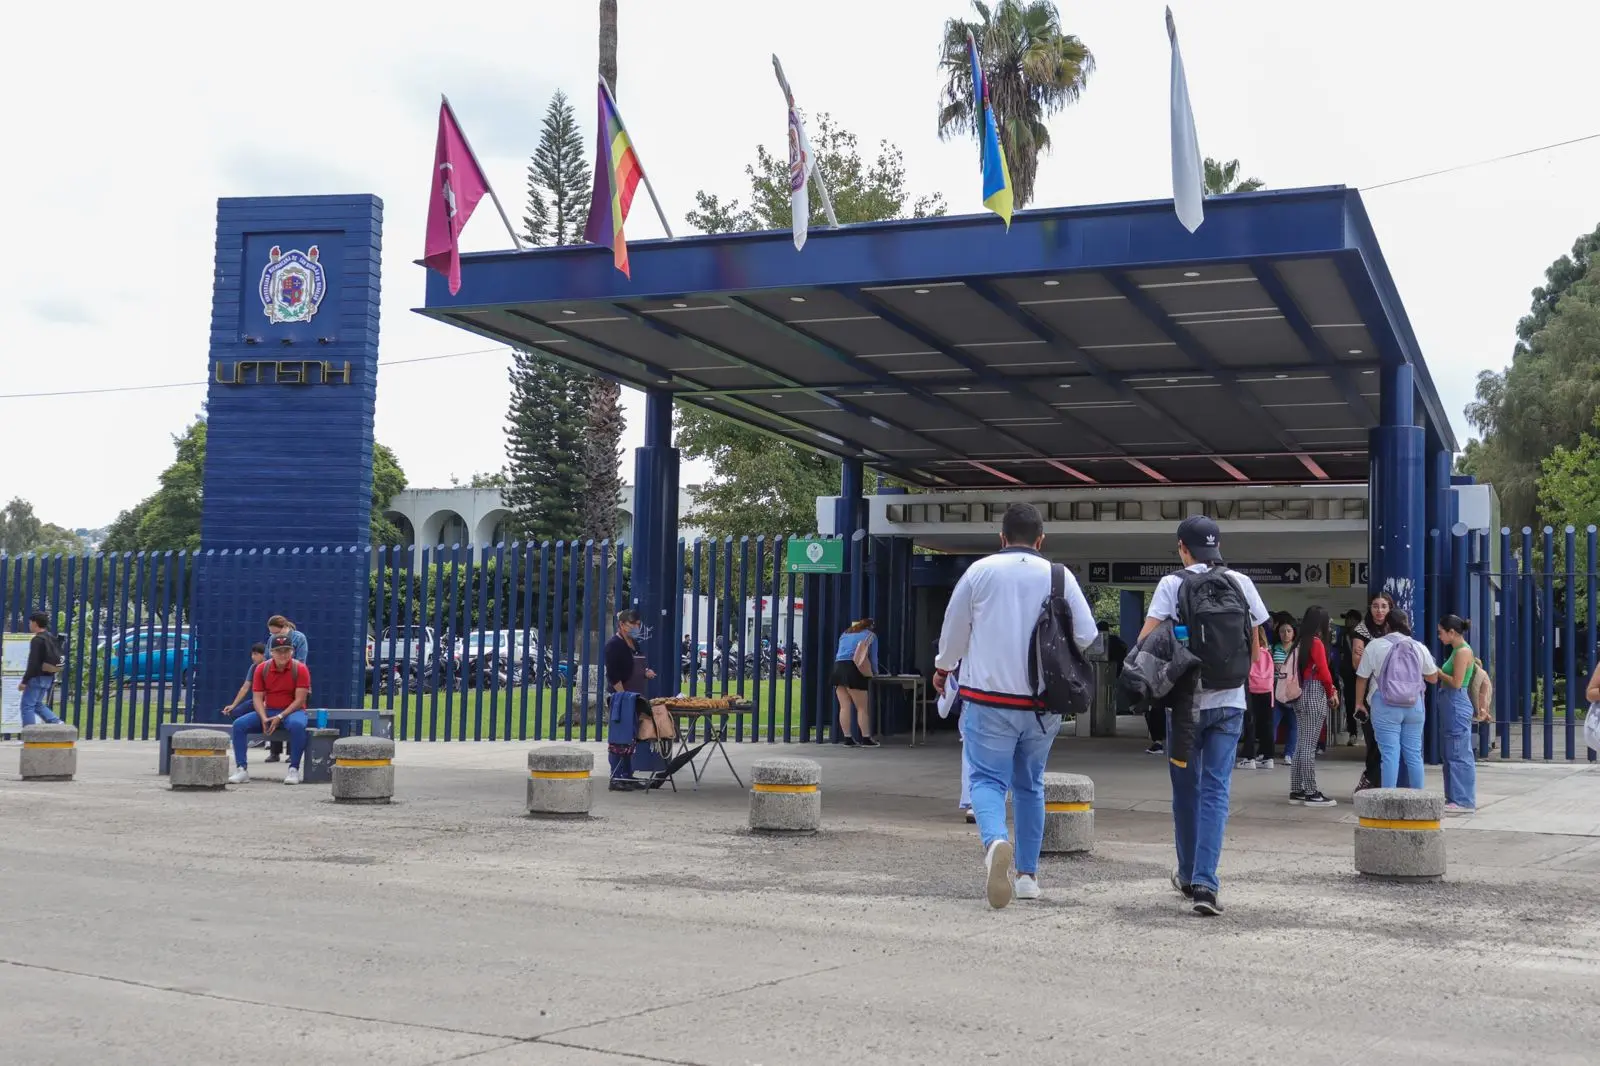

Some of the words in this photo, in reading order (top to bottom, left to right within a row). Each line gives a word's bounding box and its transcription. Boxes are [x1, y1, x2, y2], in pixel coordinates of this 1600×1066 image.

[216, 360, 351, 384] UMSNH
[1030, 501, 1142, 522] IUDAD
[1160, 498, 1368, 521] UNIVERSITA
[1093, 566, 1106, 575] AP2
